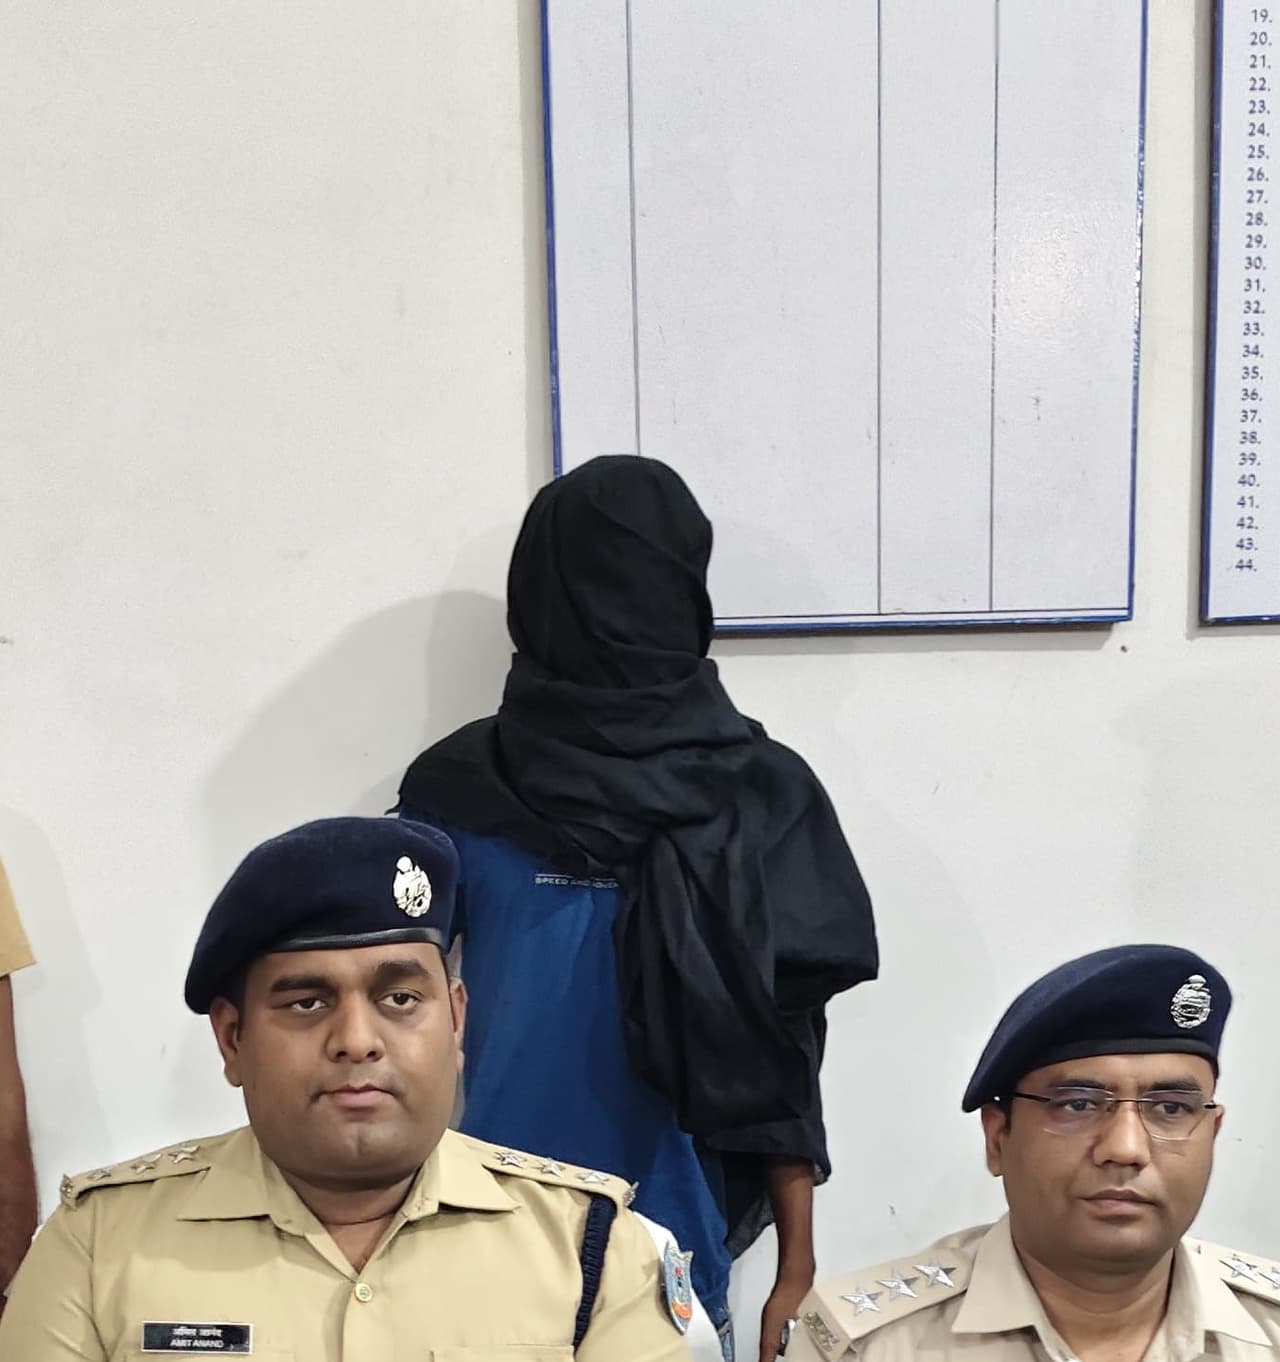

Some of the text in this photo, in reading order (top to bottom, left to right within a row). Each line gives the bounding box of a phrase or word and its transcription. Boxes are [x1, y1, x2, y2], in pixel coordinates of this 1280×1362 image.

[1251, 8, 1272, 23] 19.
[1250, 32, 1272, 46] 20.
[1249, 54, 1271, 70] 21.
[1249, 76, 1270, 92] 22.
[1248, 99, 1270, 114] 23.
[1248, 122, 1270, 137] 24.
[1248, 144, 1270, 160] 25.
[1247, 167, 1269, 182] 26.
[1246, 189, 1268, 204] 27.
[1245, 212, 1268, 226] 28.
[1245, 234, 1267, 248] 29.
[1244, 256, 1266, 270] 30.
[1244, 278, 1266, 292] 31.
[1243, 300, 1266, 314] 32.
[1243, 322, 1264, 336] 33.
[1242, 344, 1264, 358] 34.
[1240, 388, 1262, 402] 36.
[1240, 409, 1262, 423] 37.
[1235, 558, 1257, 572] 44.
